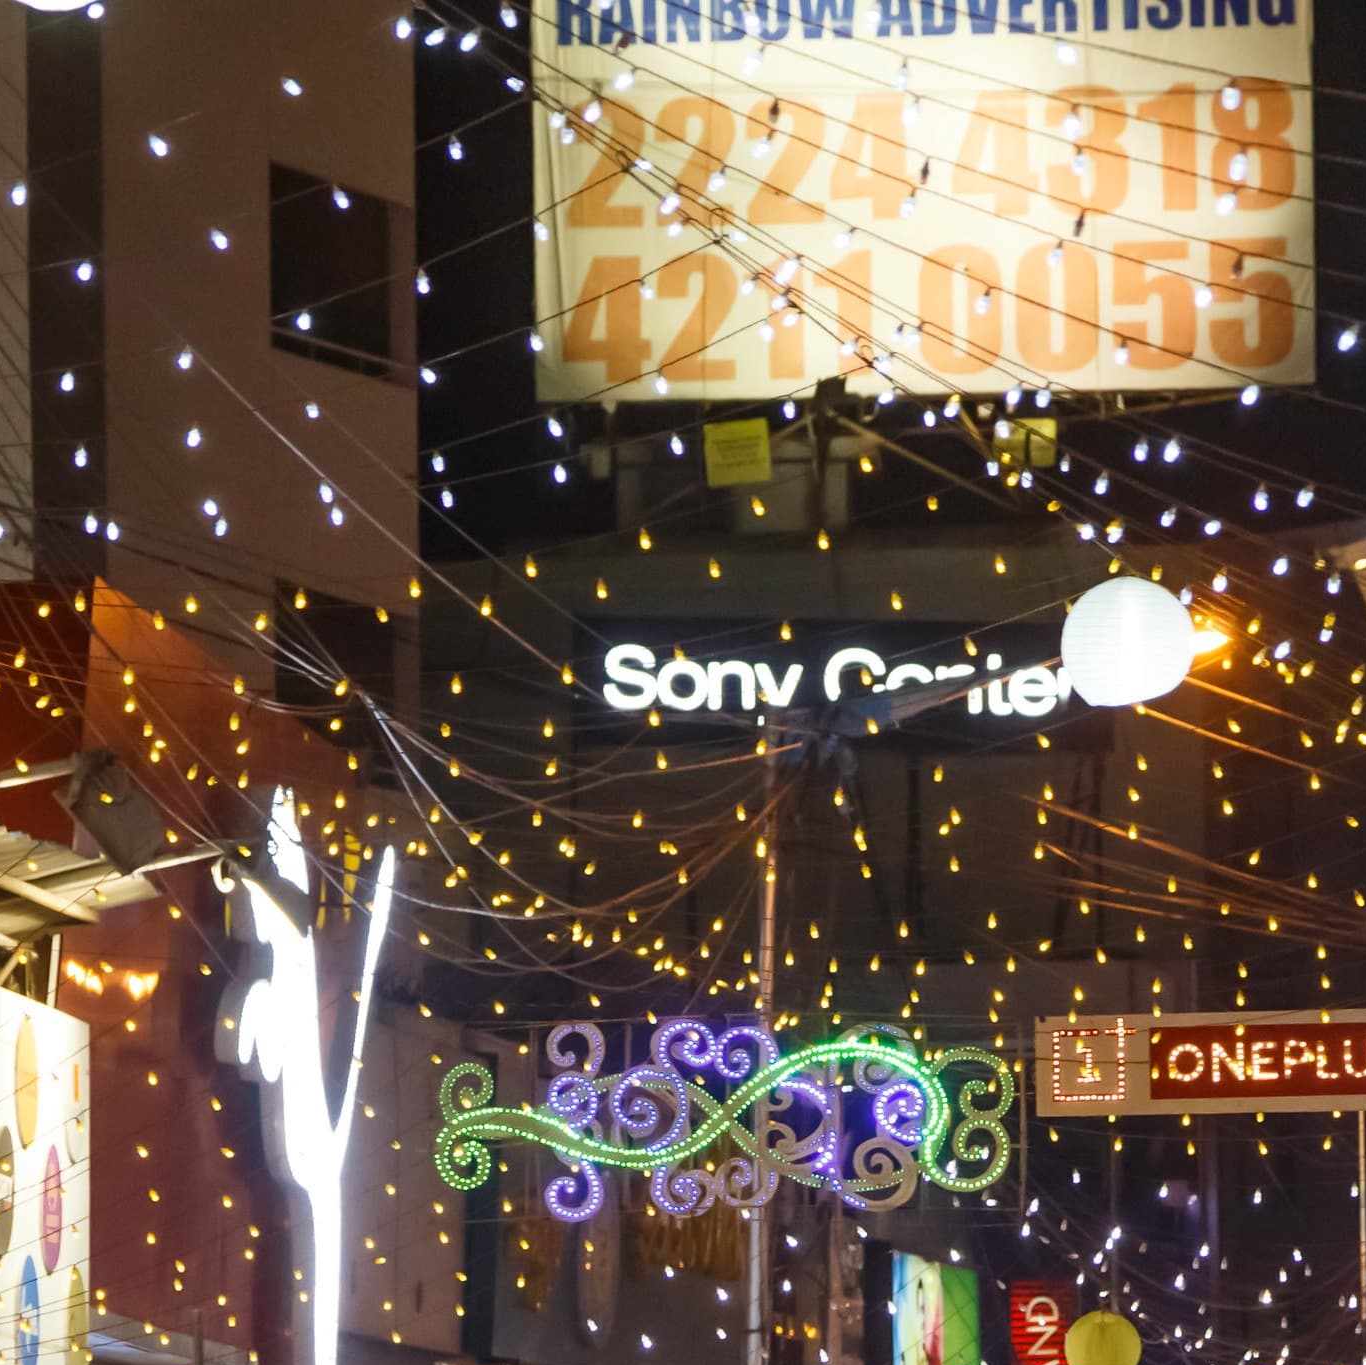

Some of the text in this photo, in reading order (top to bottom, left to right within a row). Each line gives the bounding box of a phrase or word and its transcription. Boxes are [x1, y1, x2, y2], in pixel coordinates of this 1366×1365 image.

[556, 0, 1297, 47] RAINBOW ADVERTISING
[565, 76, 1297, 228] 2224 4318
[563, 236, 1295, 383] 4211 0055
